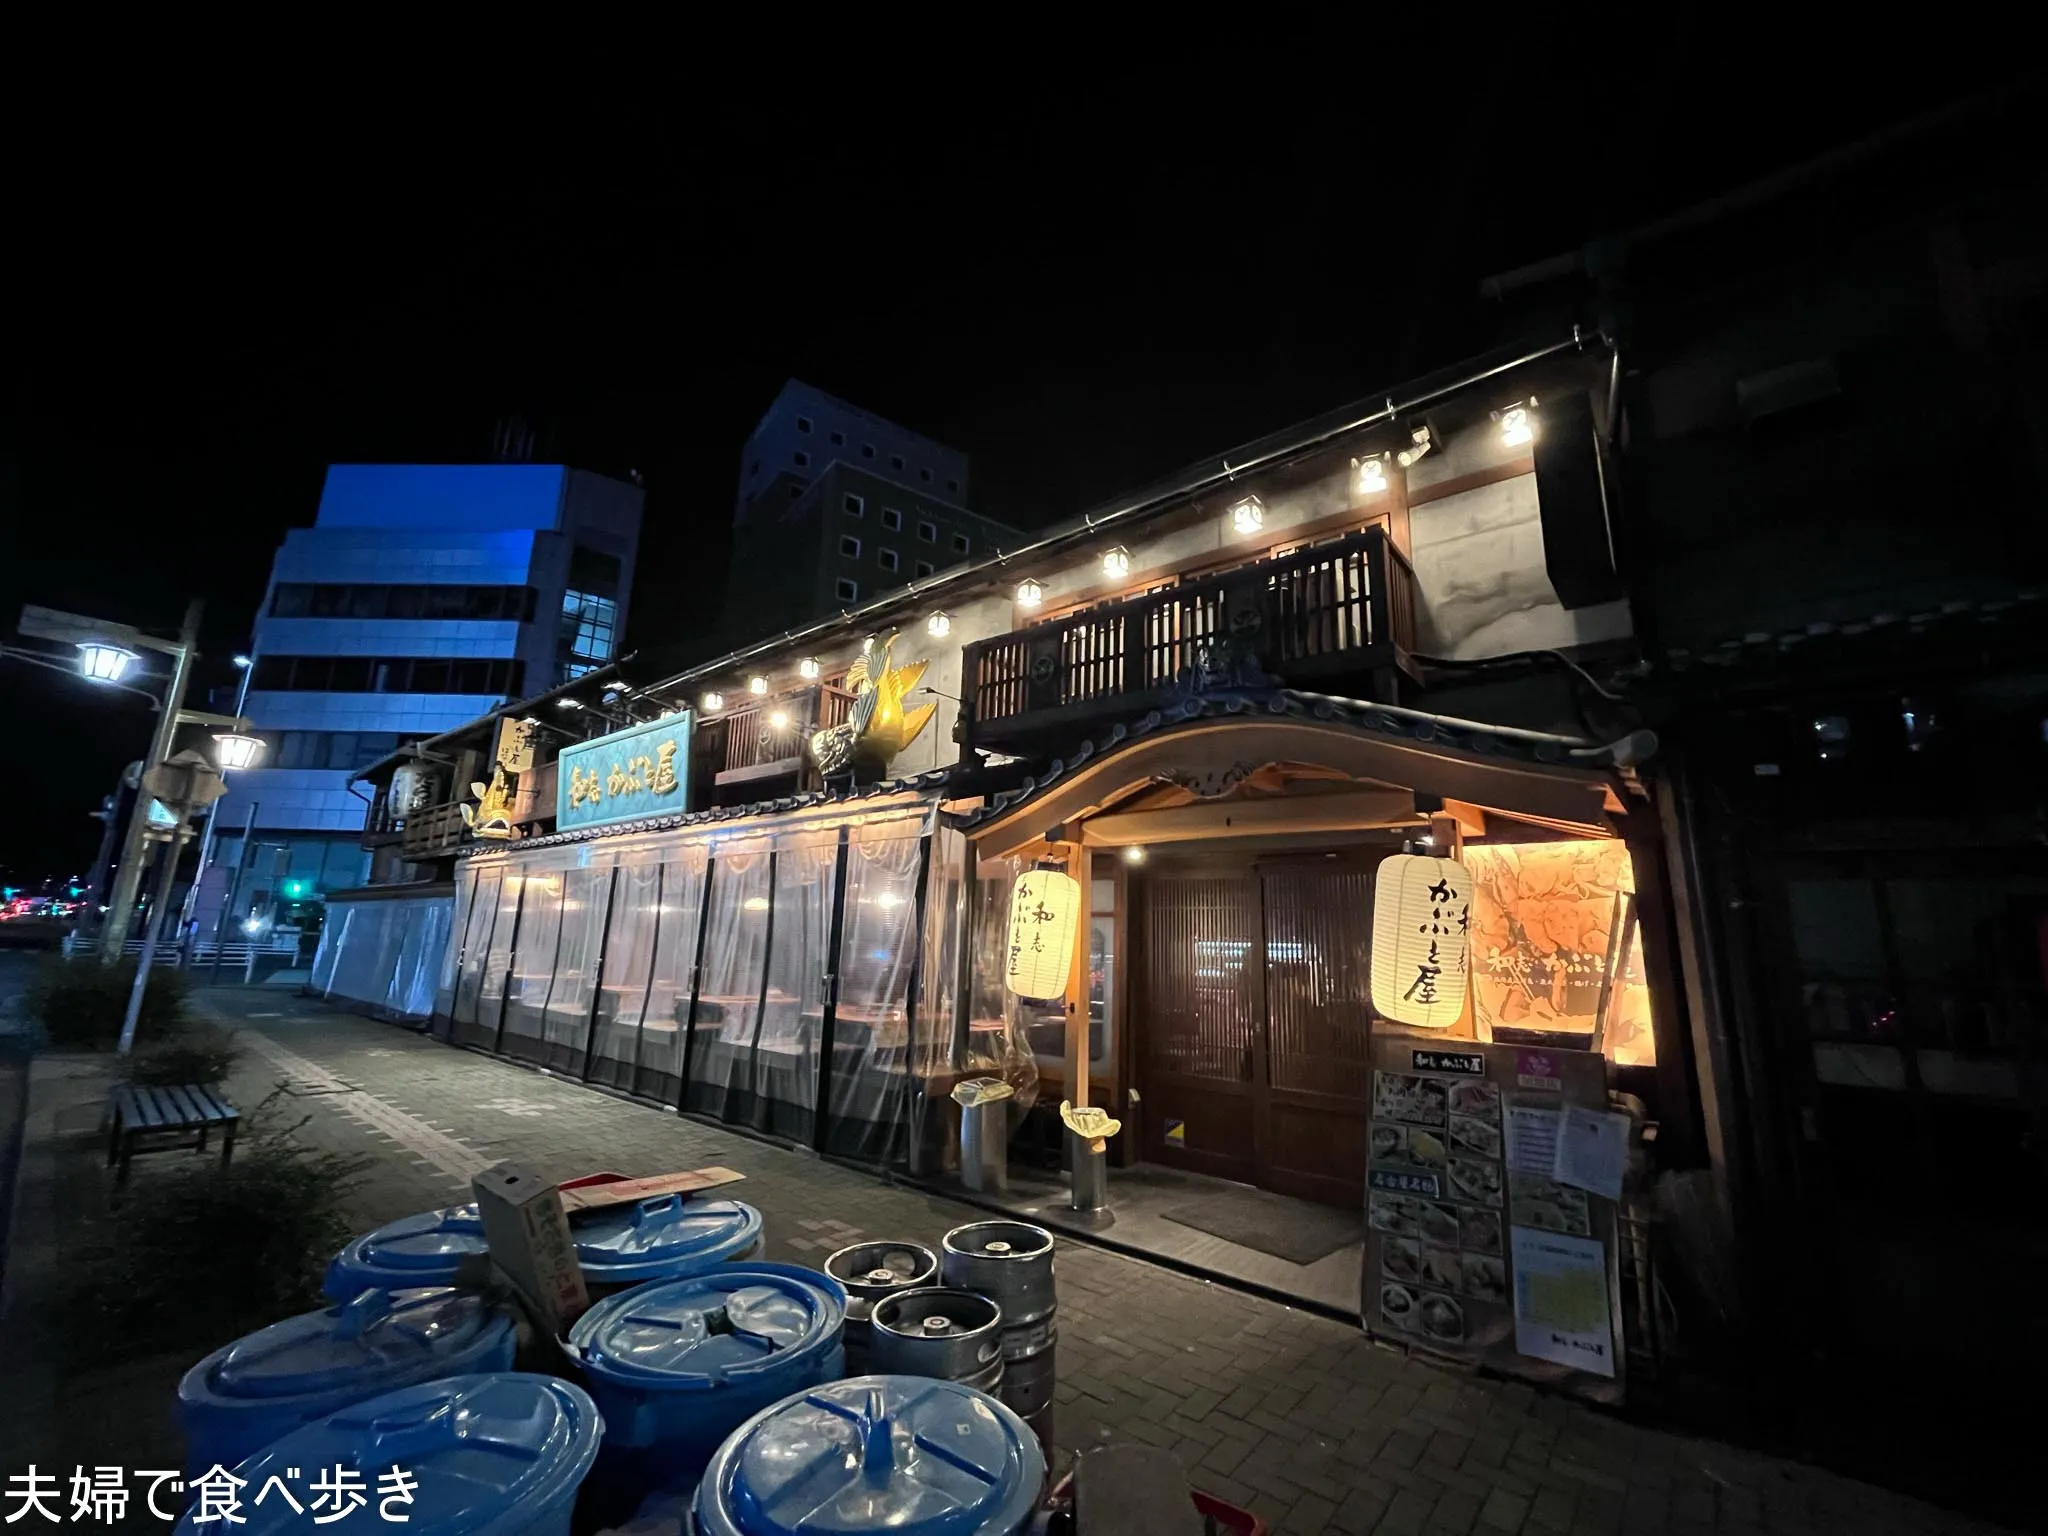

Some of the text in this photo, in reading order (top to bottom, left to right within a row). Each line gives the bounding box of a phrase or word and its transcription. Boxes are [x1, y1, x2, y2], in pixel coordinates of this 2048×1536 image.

[1009, 882, 1033, 976] かぶと屋
[1030, 901, 1055, 953] 和志
[1403, 878, 1458, 1004] かぶと屋
